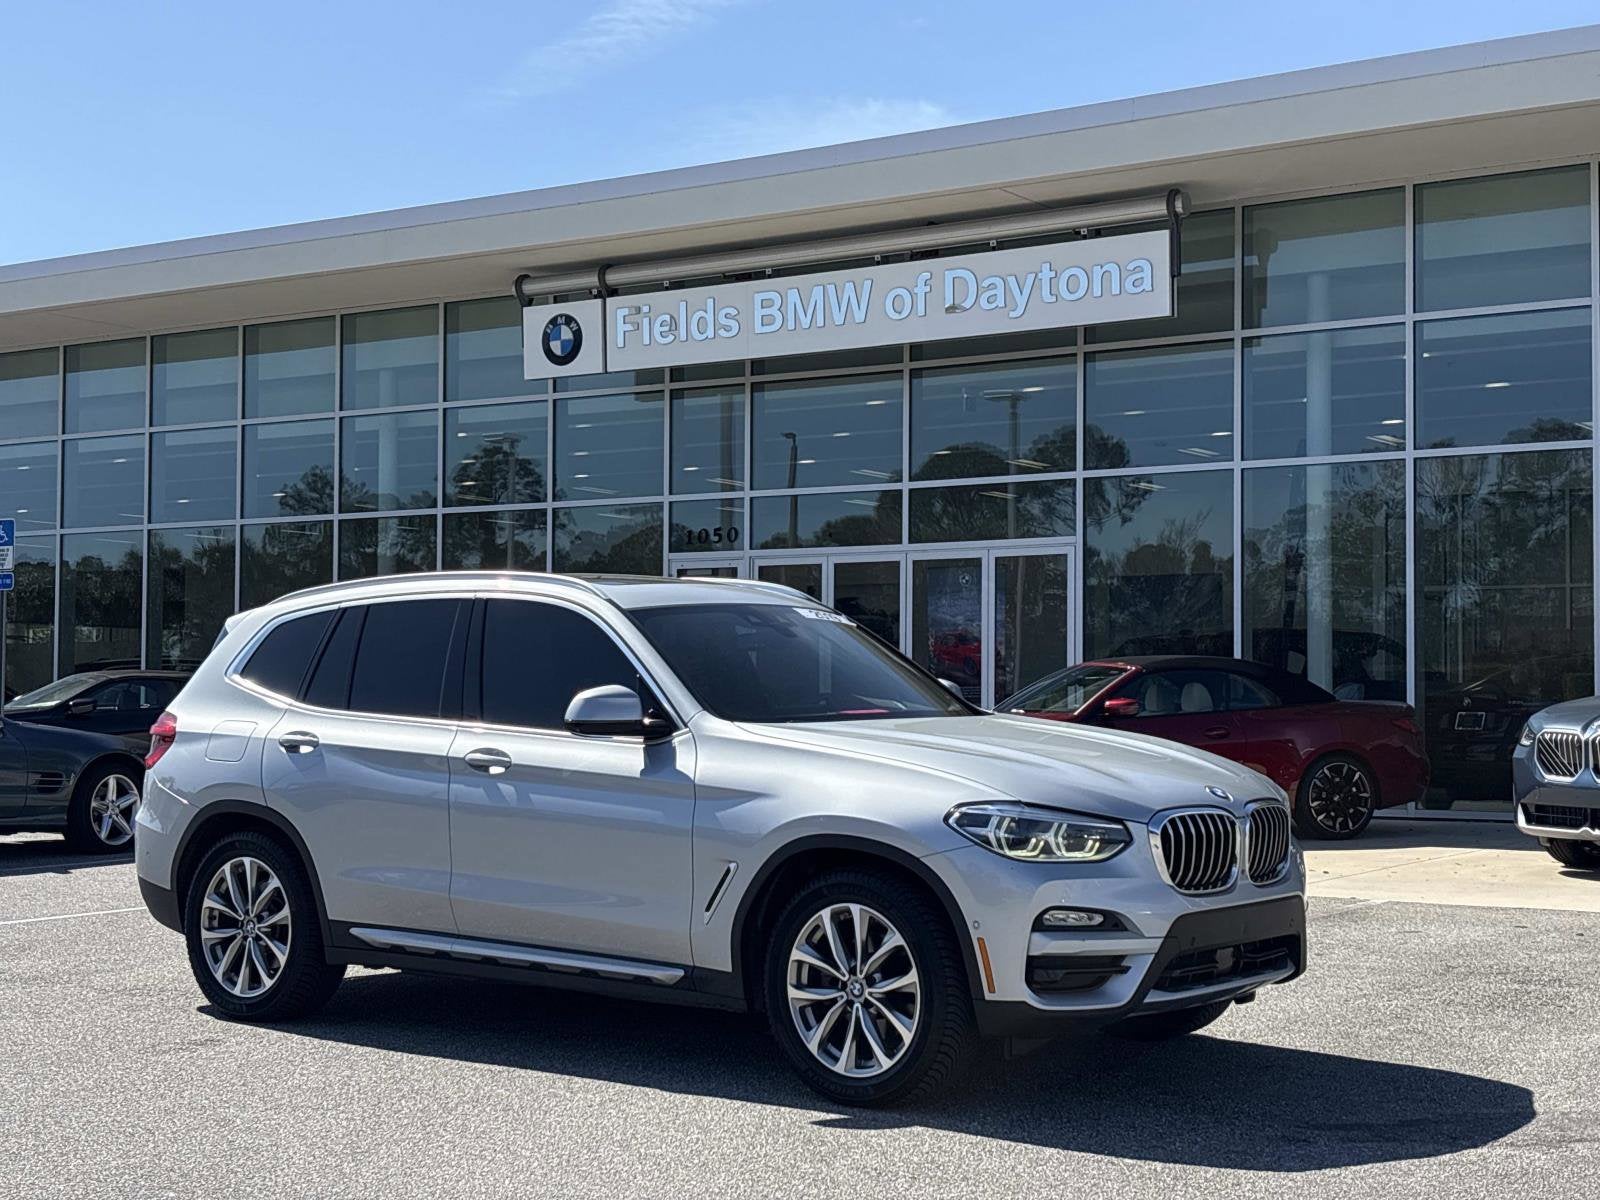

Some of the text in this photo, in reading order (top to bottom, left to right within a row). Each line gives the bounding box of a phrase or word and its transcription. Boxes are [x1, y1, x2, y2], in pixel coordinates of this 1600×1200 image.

[615, 257, 1154, 349] Fields BMW of Daytona
[545, 315, 579, 335] BMW
[686, 526, 739, 545] 1050
